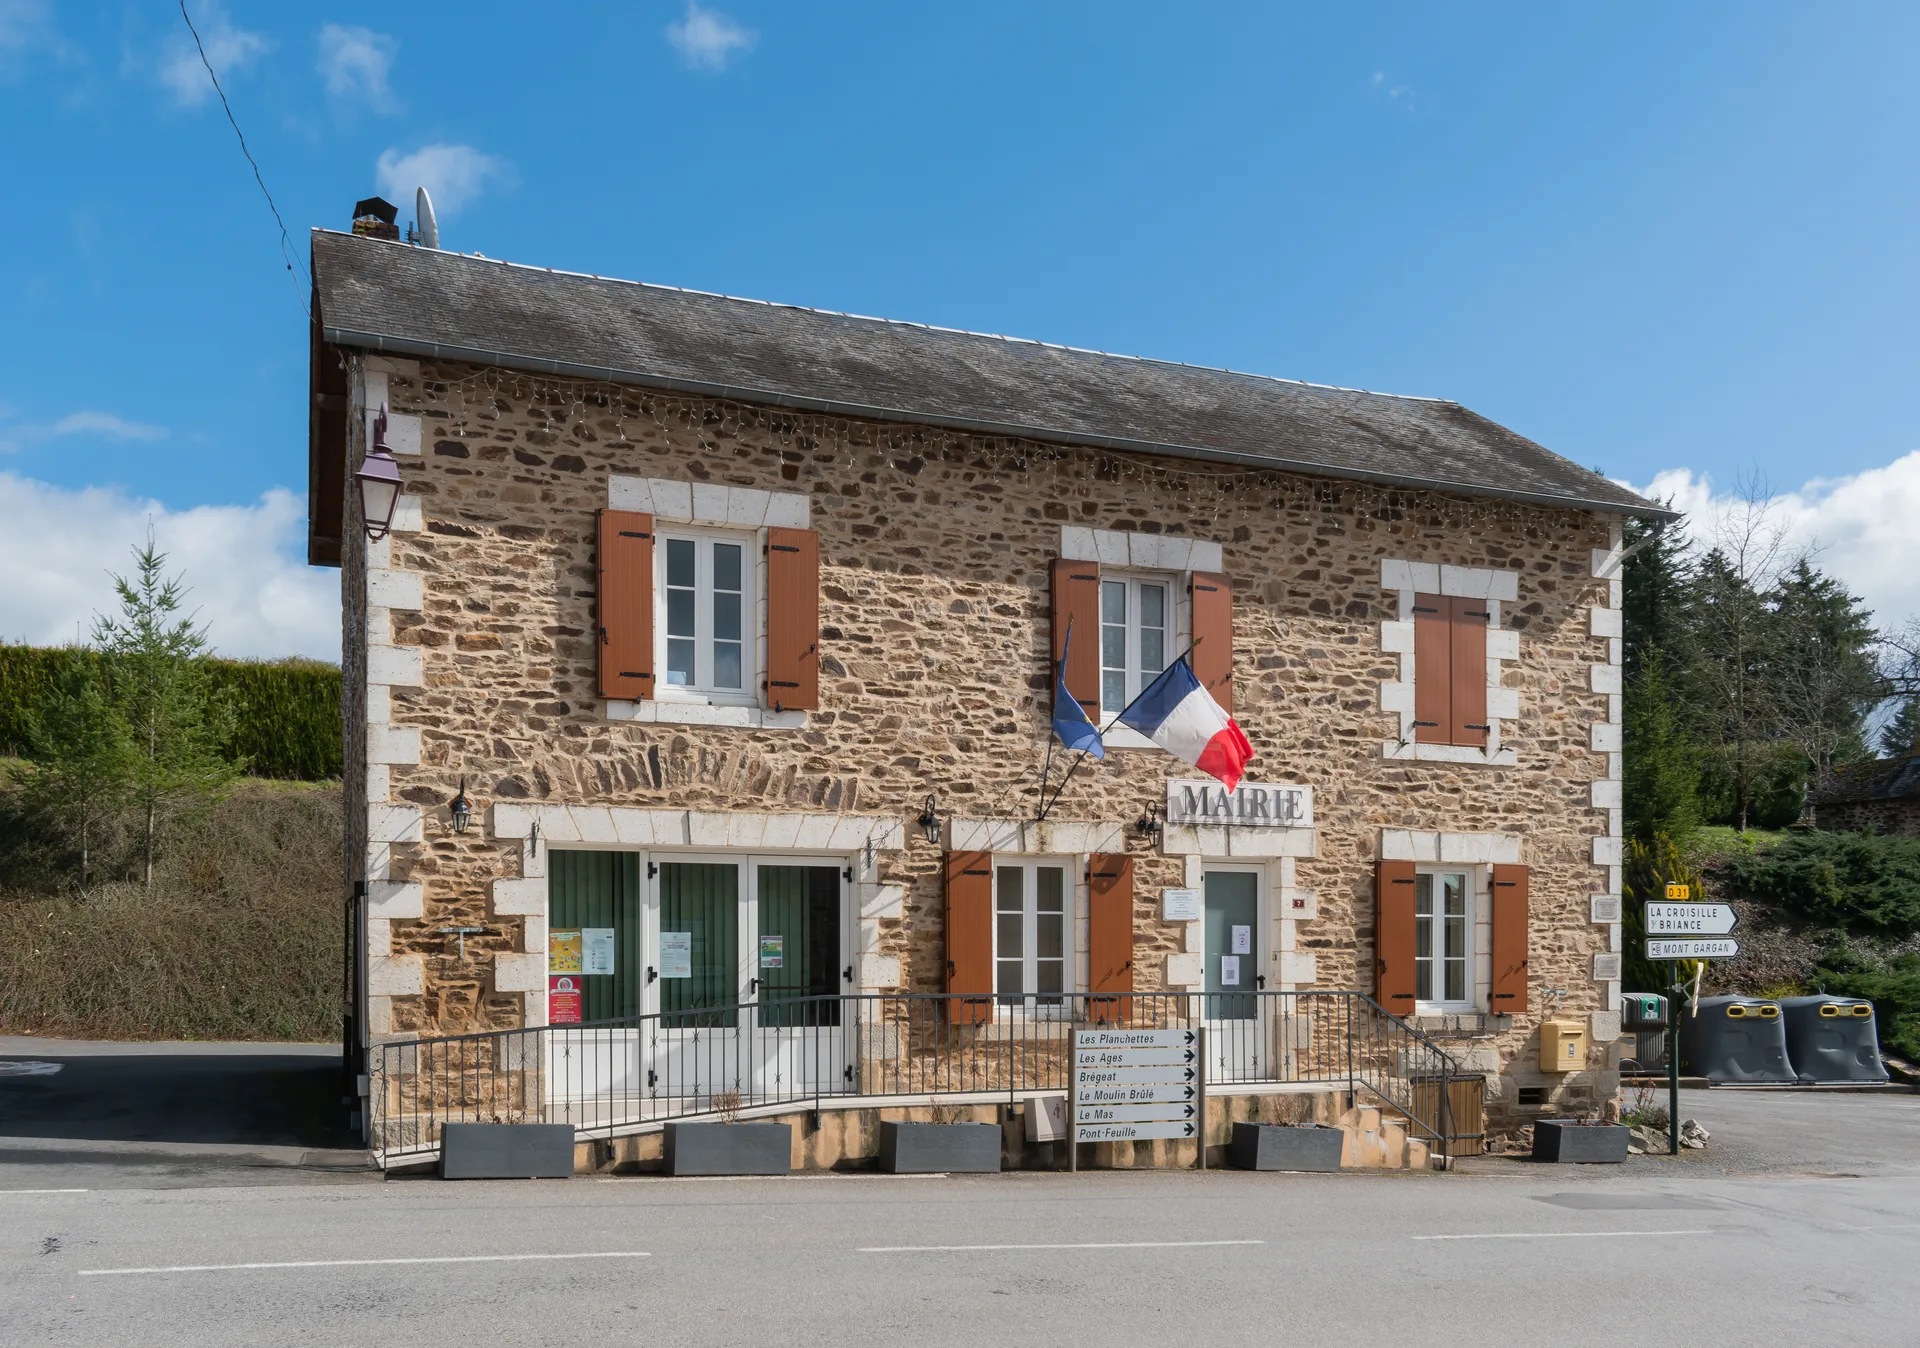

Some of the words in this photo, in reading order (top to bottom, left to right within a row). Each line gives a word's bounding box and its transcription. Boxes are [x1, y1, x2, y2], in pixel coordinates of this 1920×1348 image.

[1181, 784, 1304, 820] MAIRIE
[1668, 888, 1674, 897] D
[1677, 888, 1687, 897] 31
[1650, 907, 1662, 917] LA
[1666, 907, 1717, 918] CROISILLE
[1659, 920, 1702, 930] BRIANCE
[1663, 944, 1689, 954] MONT
[1693, 943, 1730, 954] GARGAN
[1080, 1034, 1096, 1044] Les
[1100, 1033, 1155, 1044] Planchettes
[1080, 1053, 1095, 1063] Les
[1100, 1052, 1123, 1065] Ages
[1080, 1071, 1117, 1084] Brégeat
[1080, 1091, 1090, 1101] Le
[1094, 1090, 1126, 1101] Moulin
[1129, 1088, 1154, 1100] Brûlé
[1080, 1110, 1090, 1120] Le
[1094, 1109, 1114, 1119] Mas
[1080, 1127, 1136, 1139] Pont-Feuille
